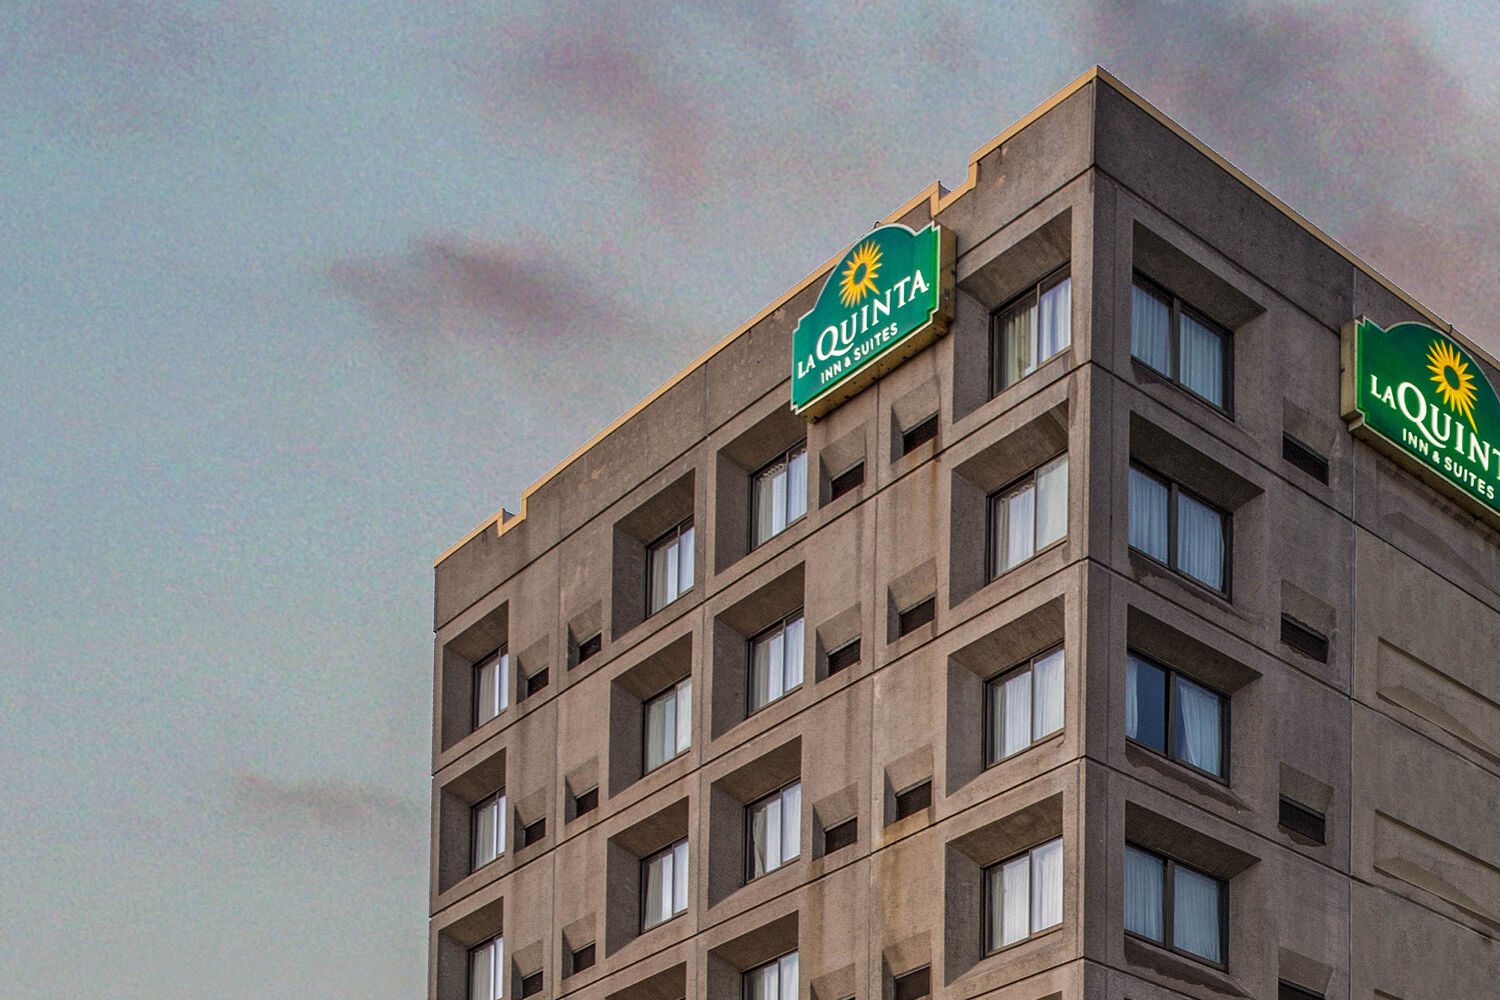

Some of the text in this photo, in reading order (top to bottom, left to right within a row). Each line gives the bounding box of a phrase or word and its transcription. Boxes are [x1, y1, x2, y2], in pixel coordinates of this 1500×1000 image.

[797, 269, 928, 379] LA QUINTA
[820, 359, 842, 384] INN
[854, 322, 898, 361] SUITES
[1370, 374, 1397, 410] LA
[1402, 428, 1495, 500] INN & SUITES
